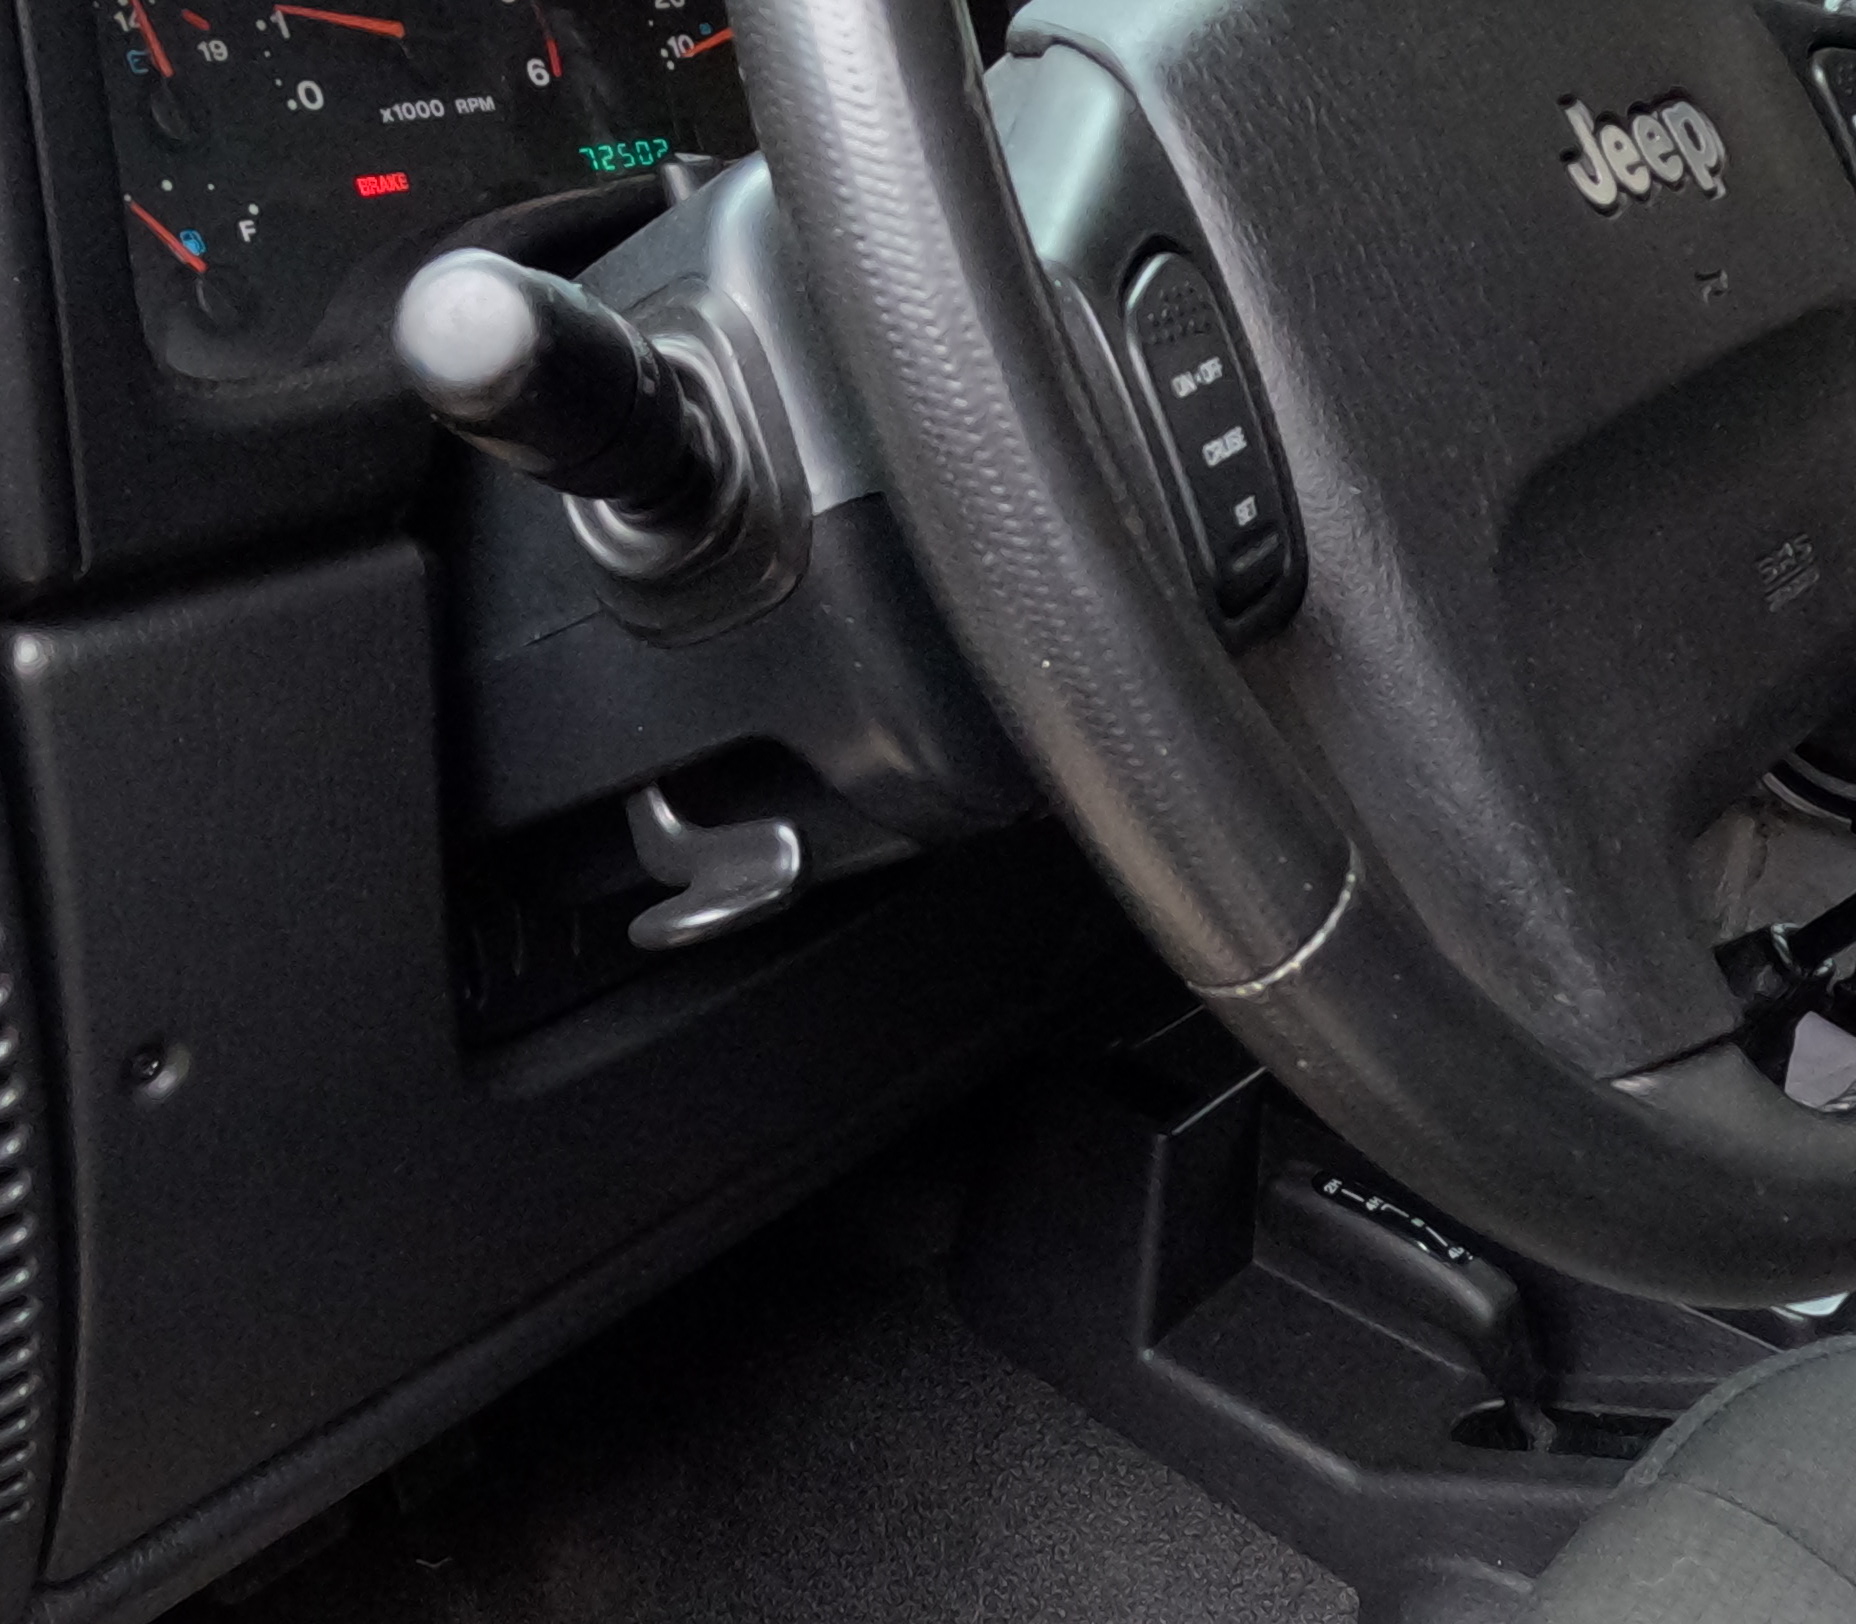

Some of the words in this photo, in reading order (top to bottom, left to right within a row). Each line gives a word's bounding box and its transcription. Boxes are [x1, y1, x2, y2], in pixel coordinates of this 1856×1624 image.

[270, 9, 291, 40] 1
[197, 39, 229, 62] 19
[666, 34, 694, 59] 10
[526, 58, 550, 87] 6
[296, 79, 325, 111] 0
[379, 99, 445, 124] x1000
[454, 96, 496, 114] RPM
[1562, 97, 1726, 212] Jeep
[355, 172, 410, 198] BRAKE
[238, 220, 256, 242] F
[1323, 1178, 1343, 1194] 2H
